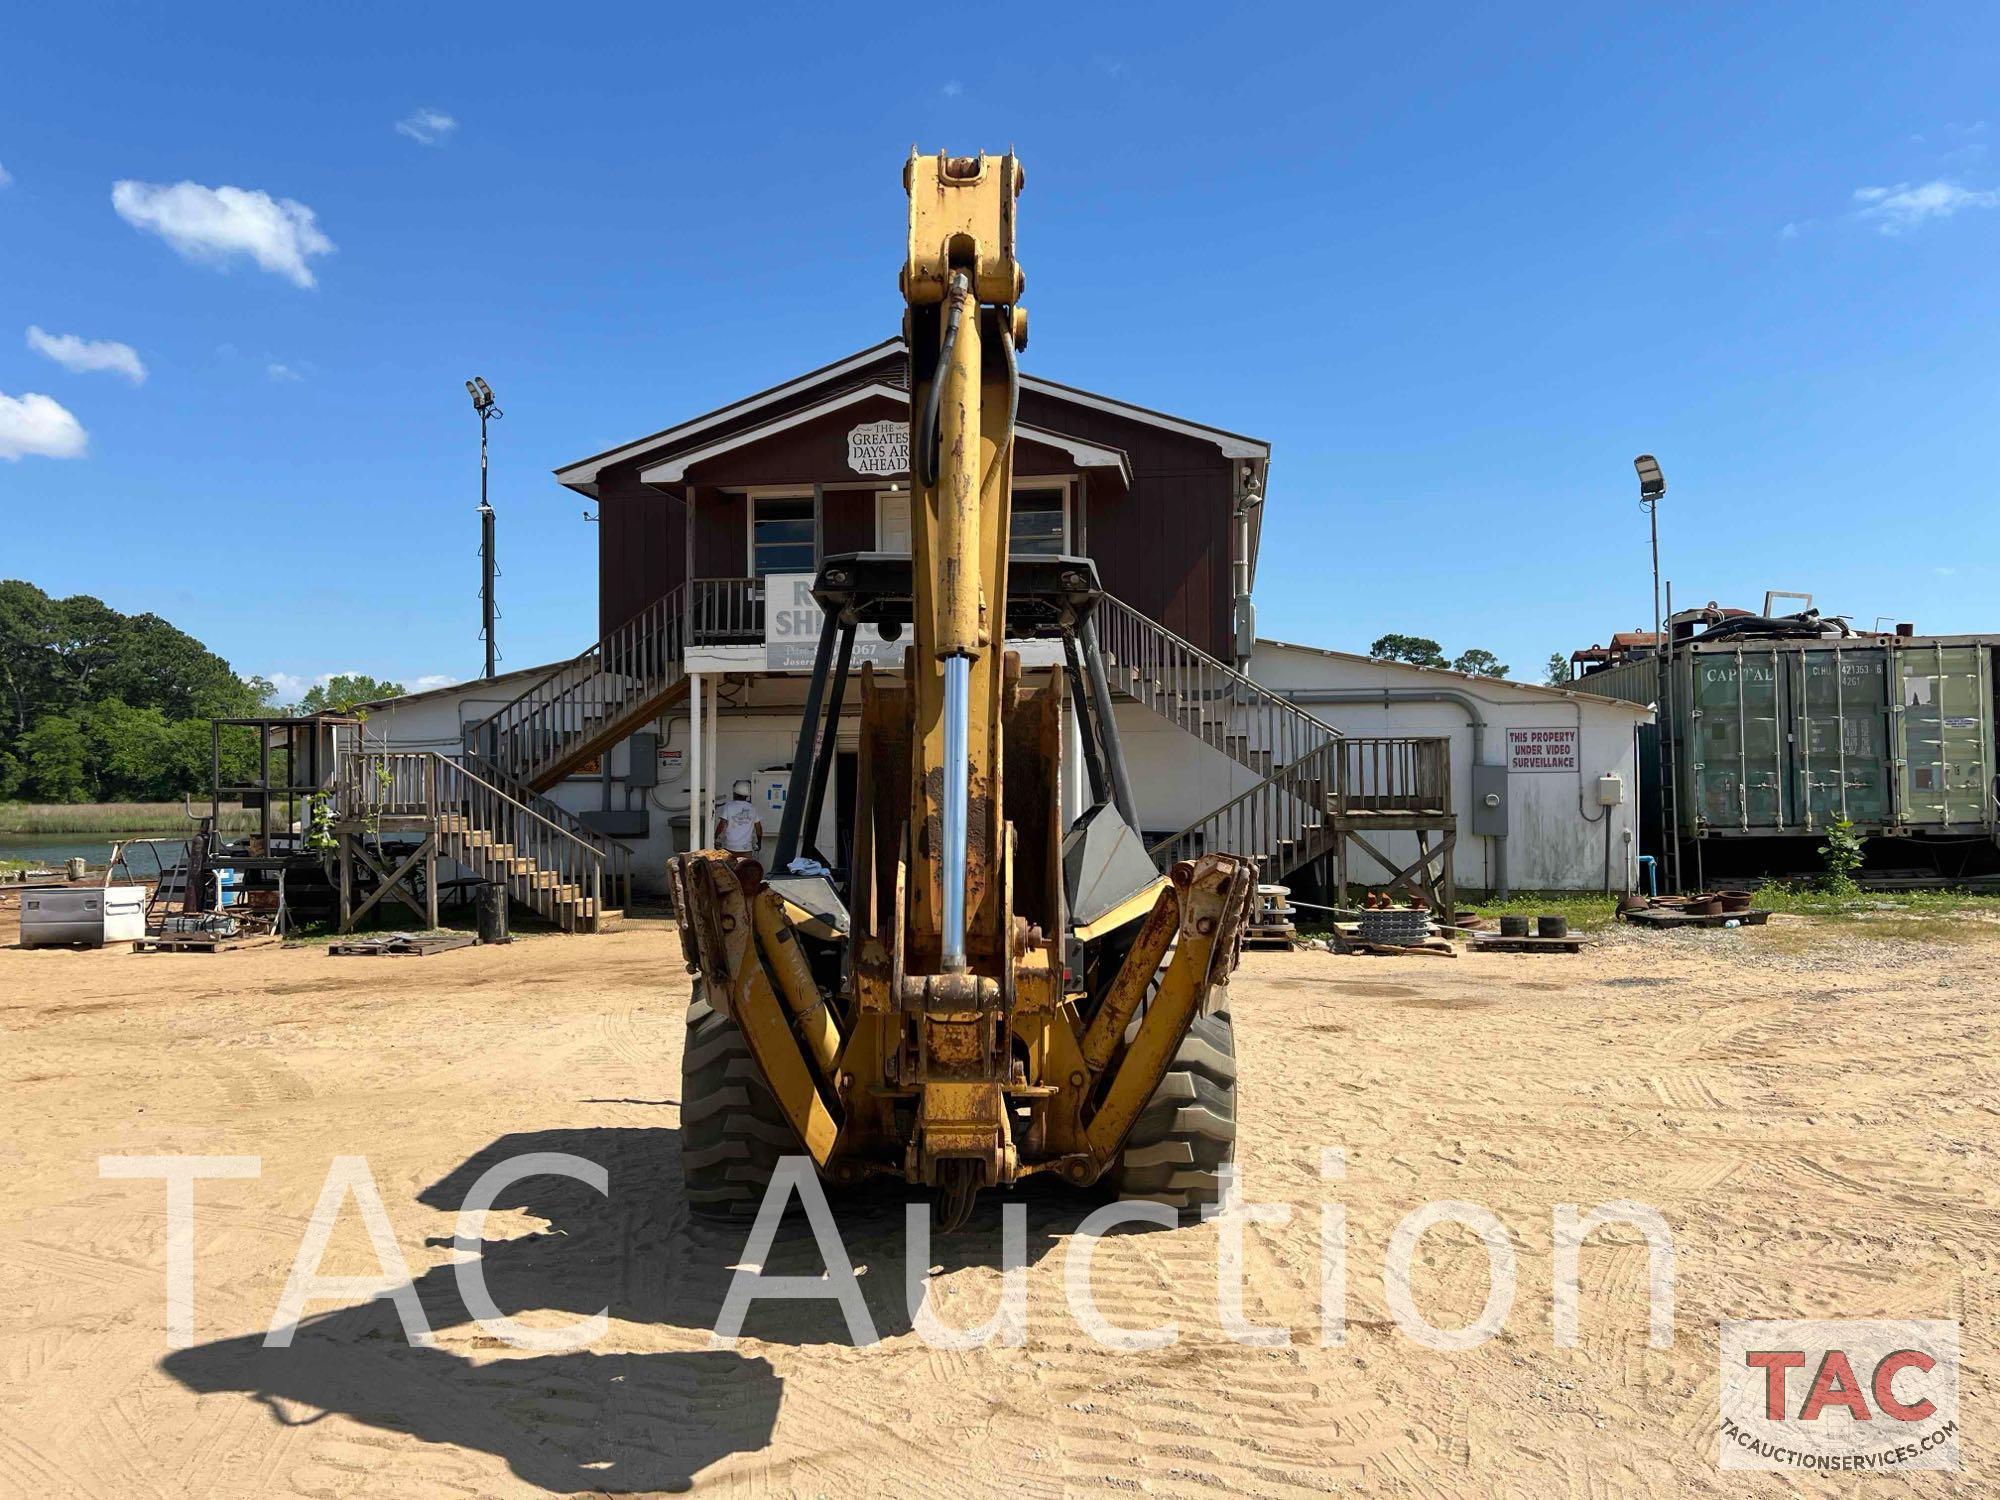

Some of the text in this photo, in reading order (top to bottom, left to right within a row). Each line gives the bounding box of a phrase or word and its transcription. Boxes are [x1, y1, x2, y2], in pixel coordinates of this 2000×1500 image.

[874, 424, 894, 433] THE
[852, 433, 909, 445] GREATES
[852, 445, 909, 458] DAYS AR
[859, 458, 908, 471] AHEAD
[1706, 668, 1775, 682] CAPTAL
[1509, 731, 1575, 743] THIS PROPERTY
[1515, 744, 1571, 756] UNDER VIDEO
[1512, 757, 1575, 768] SURVEILLANCE
